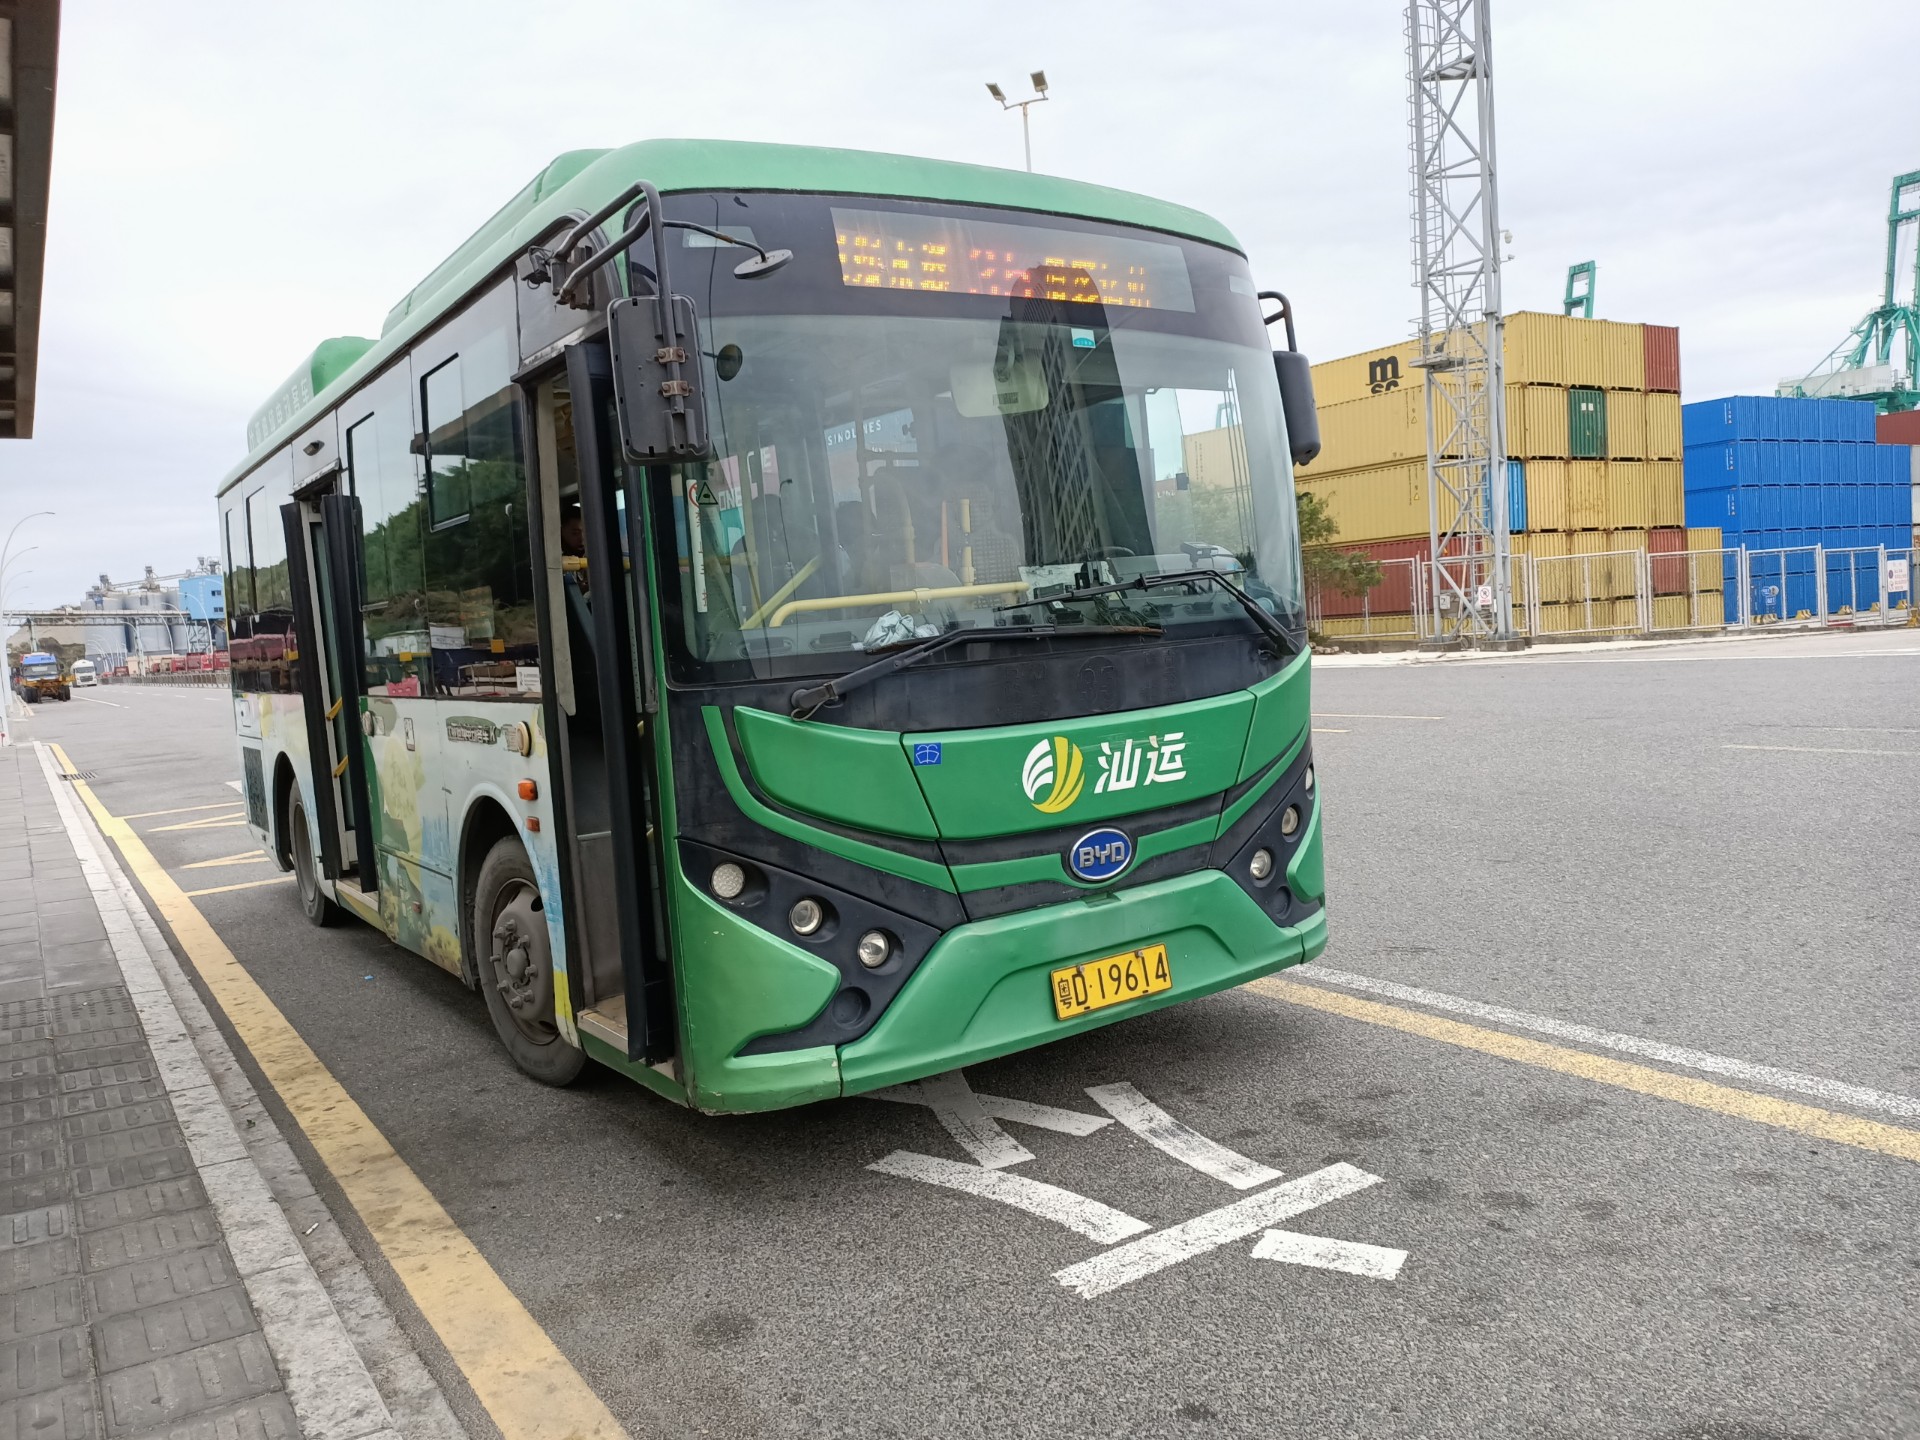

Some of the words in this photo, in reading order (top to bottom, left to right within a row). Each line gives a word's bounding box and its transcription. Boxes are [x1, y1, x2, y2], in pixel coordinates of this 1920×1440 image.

[827, 418, 882, 446] SINOLNES
[1094, 731, 1187, 794] 汕运
[1078, 841, 1125, 868] BYD
